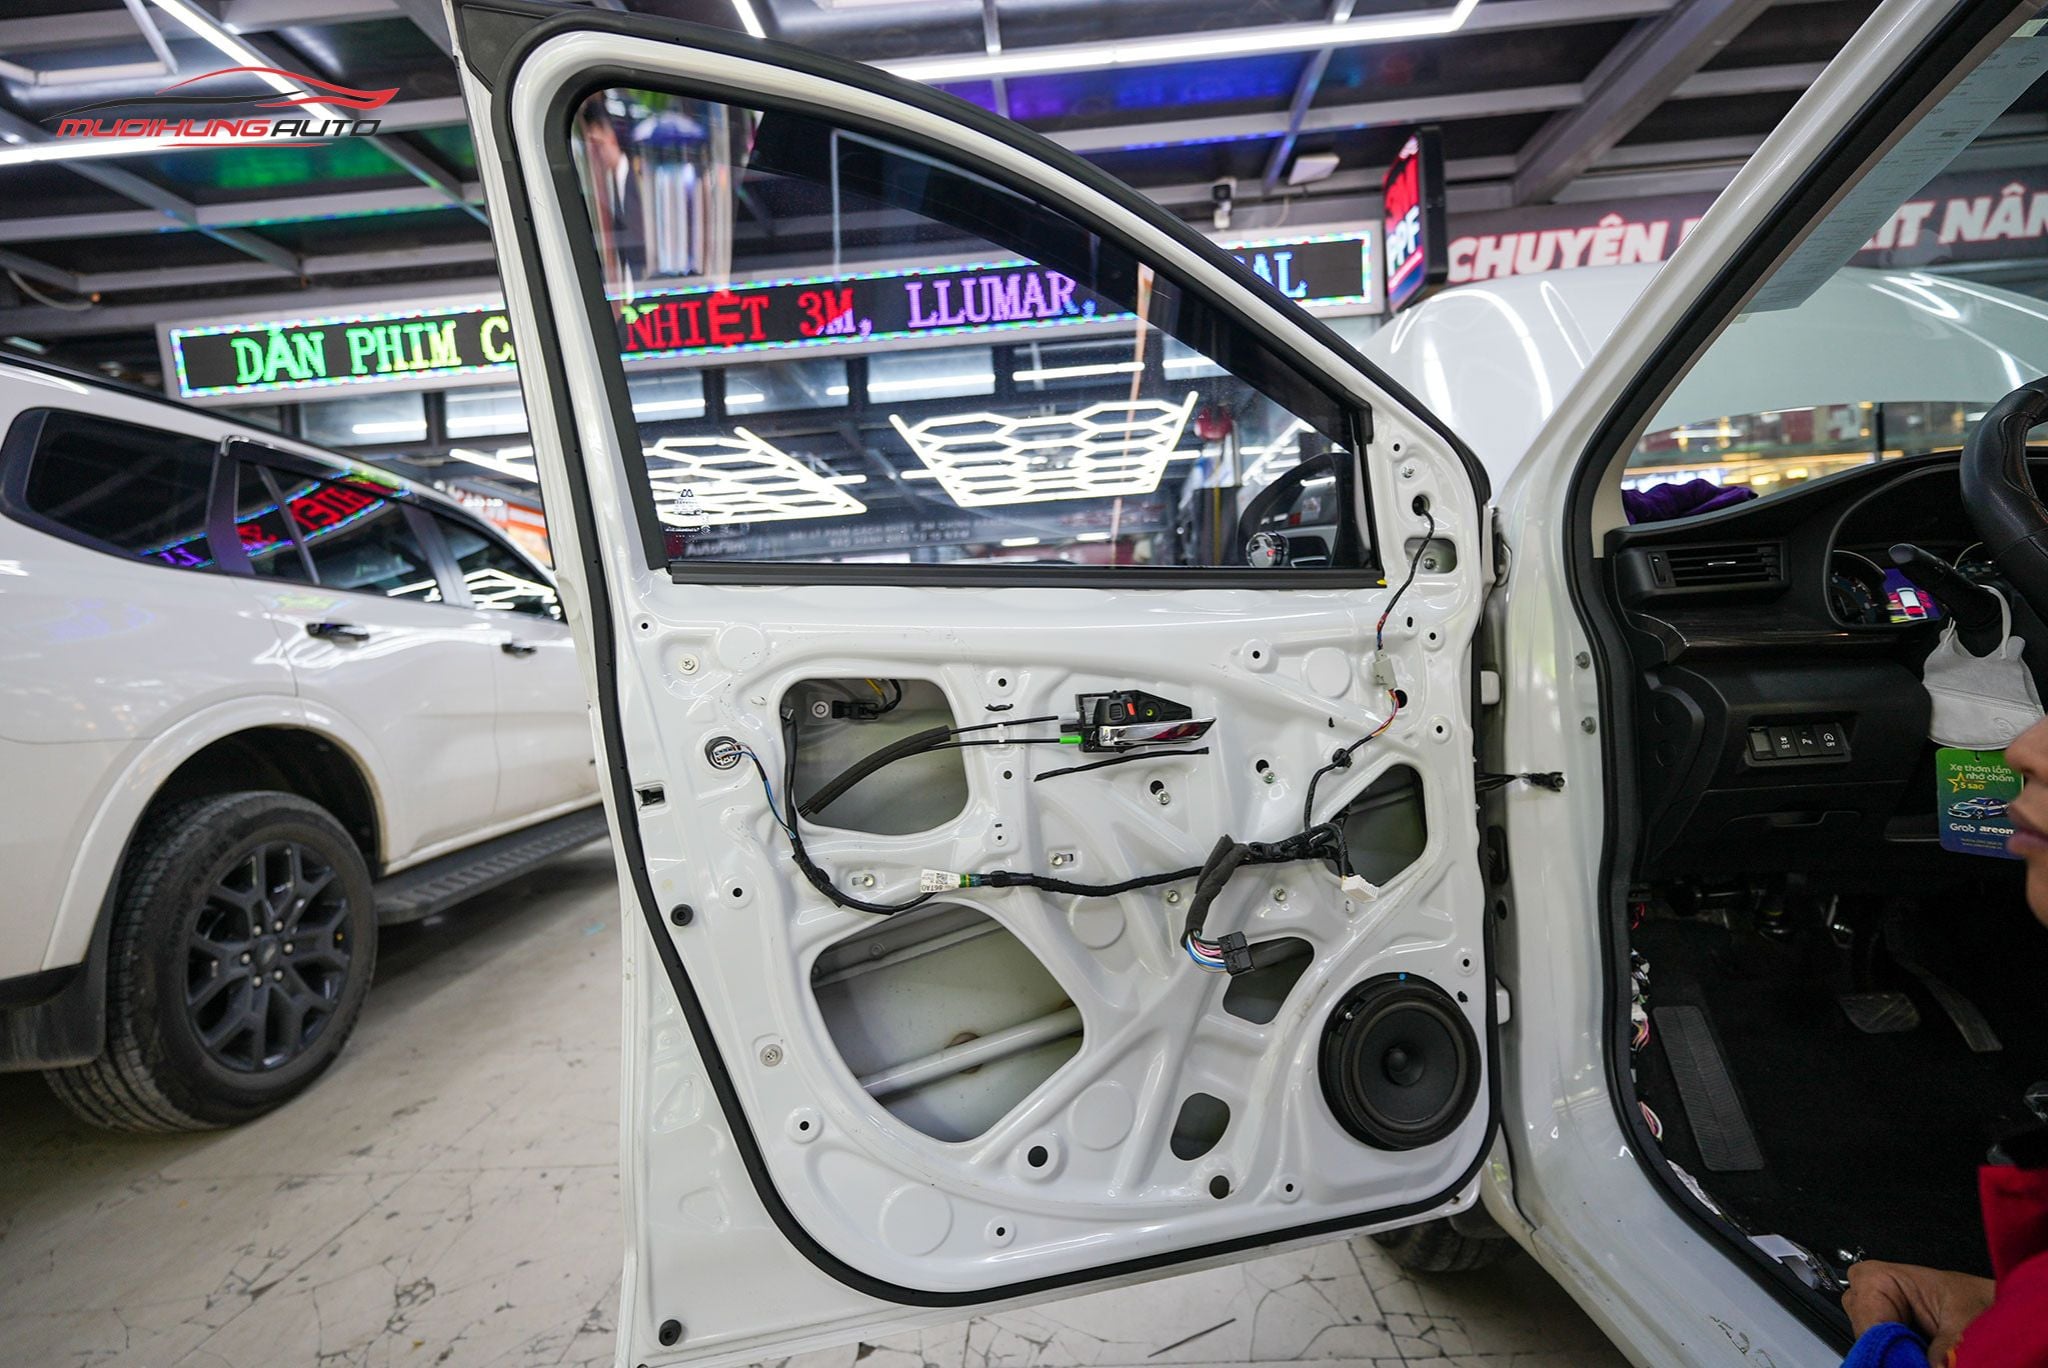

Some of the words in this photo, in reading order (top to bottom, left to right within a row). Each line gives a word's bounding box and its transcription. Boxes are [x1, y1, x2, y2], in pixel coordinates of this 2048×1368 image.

[1447, 212, 1670, 283] CHUYÊN
[346, 319, 462, 375] PHIM
[798, 287, 873, 337] 3M,
[904, 270, 1097, 329] LLUMAR,
[1949, 763, 1964, 771] Xe
[1949, 823, 1976, 833] Grab
[1979, 825, 2014, 835] areon
